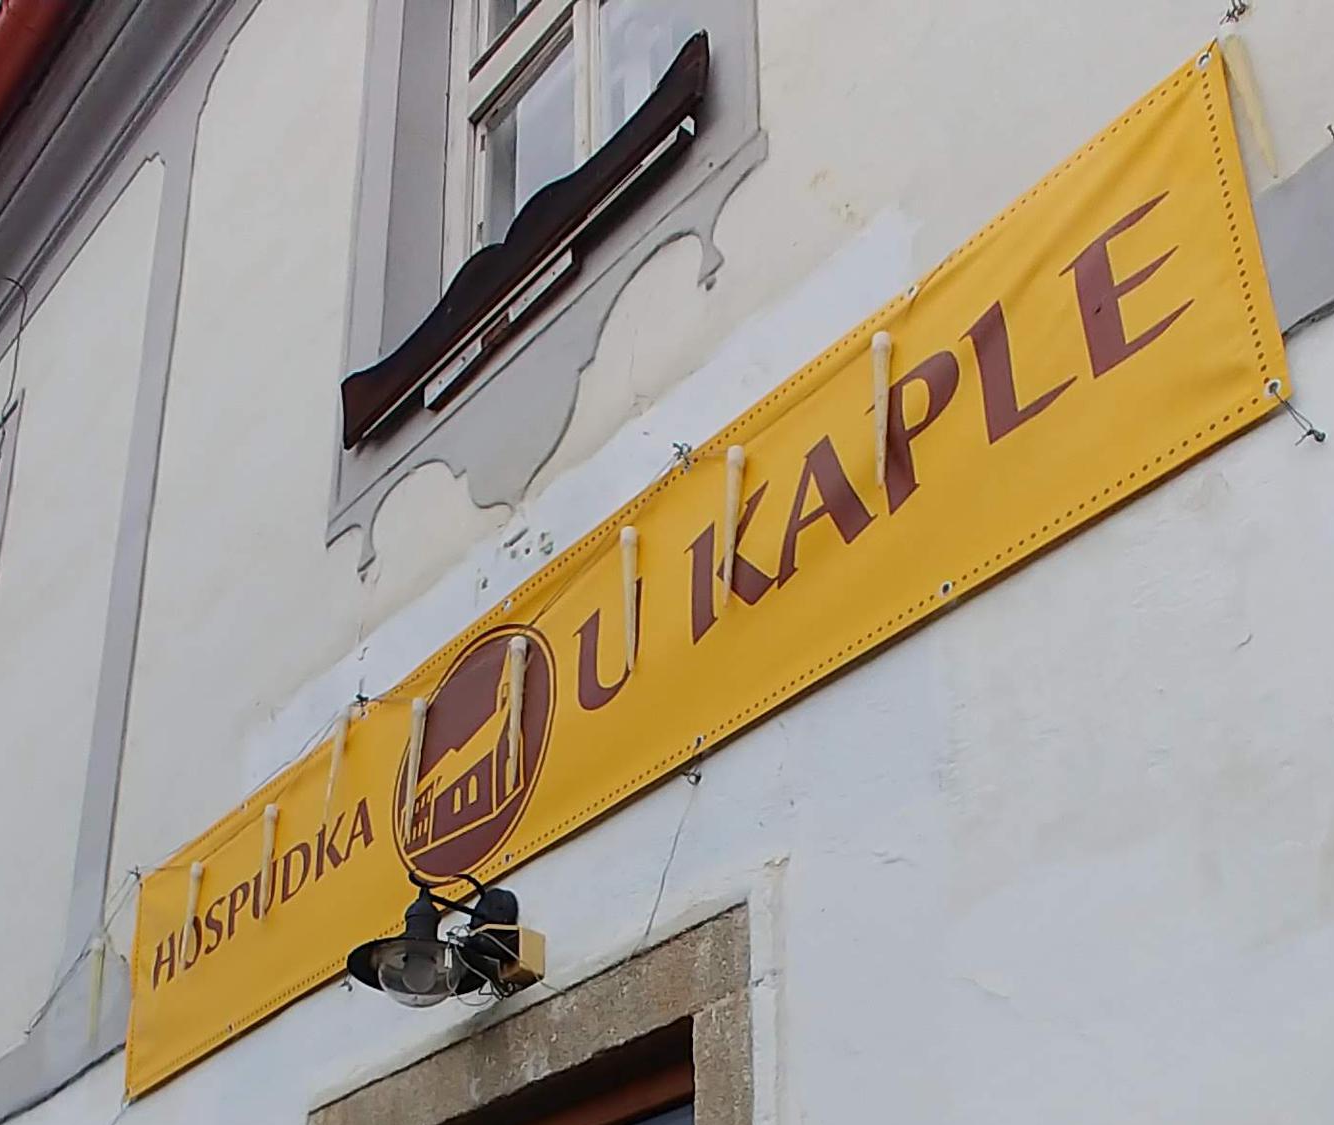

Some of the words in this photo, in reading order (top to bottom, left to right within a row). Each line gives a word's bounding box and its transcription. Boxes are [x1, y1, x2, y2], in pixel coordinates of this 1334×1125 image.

[152, 796, 375, 992] HOSPUDKA
[572, 577, 643, 712] U
[682, 189, 1197, 646] KAPLE
